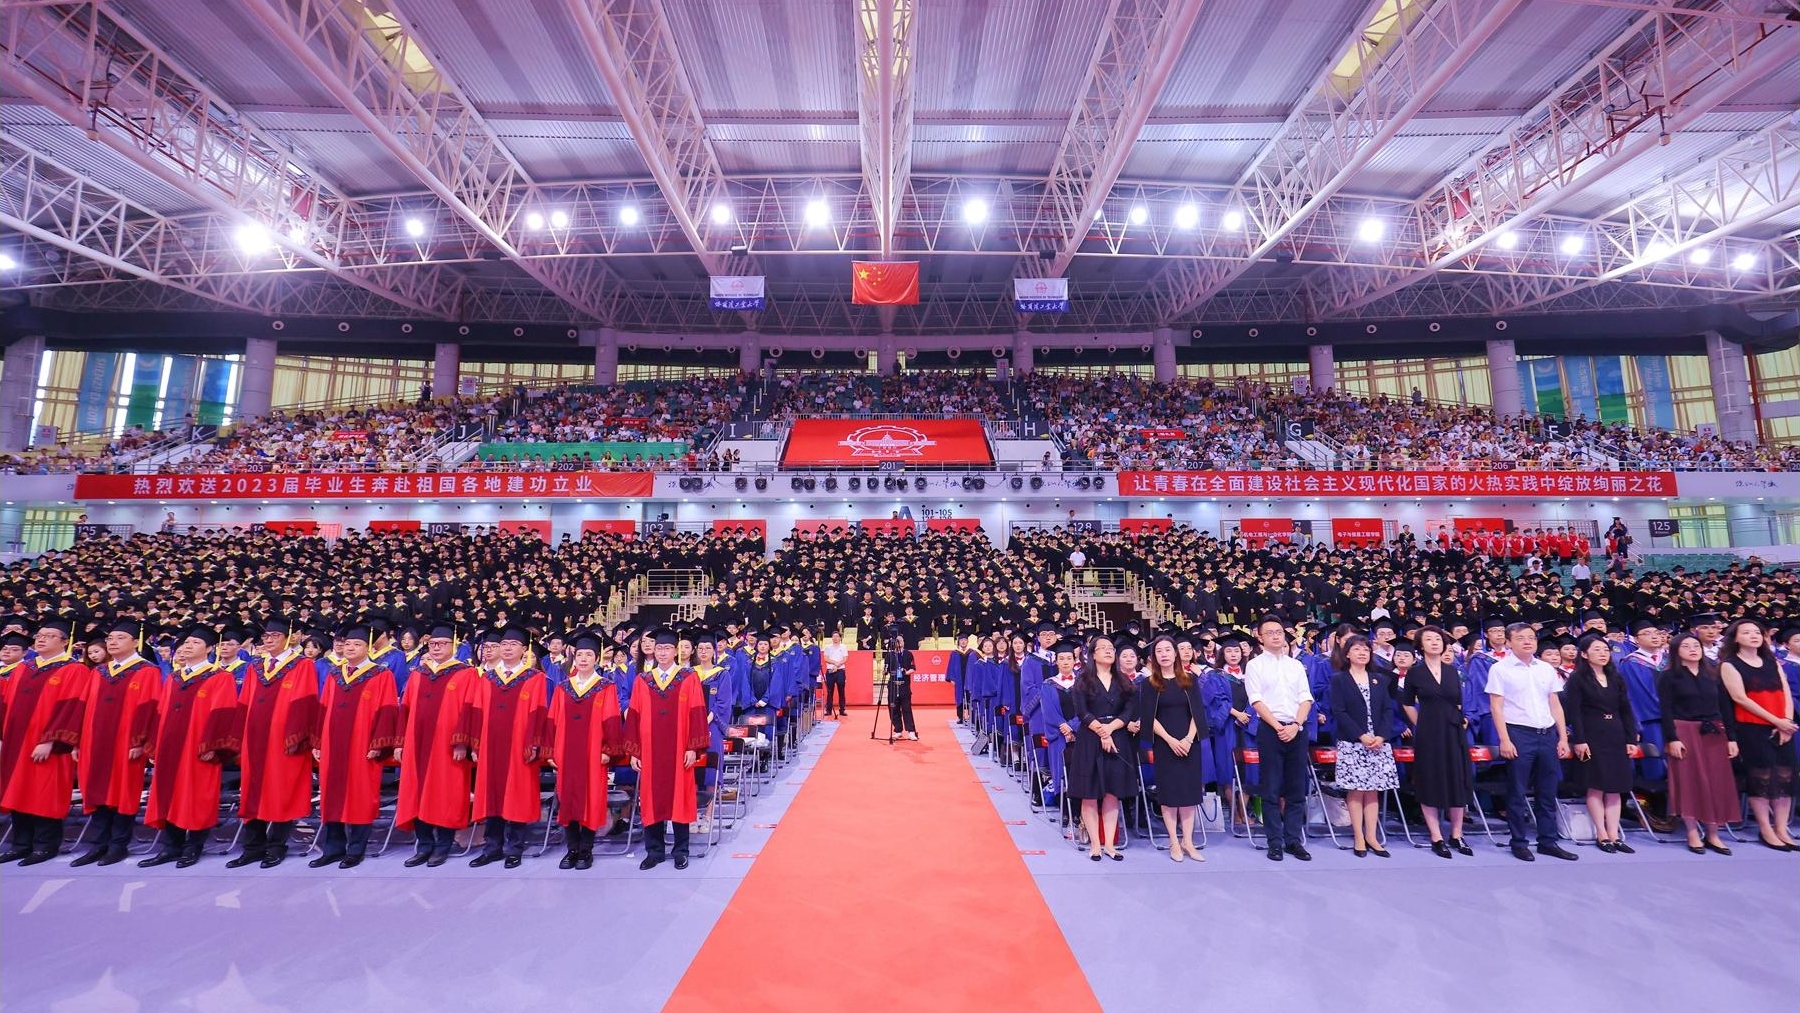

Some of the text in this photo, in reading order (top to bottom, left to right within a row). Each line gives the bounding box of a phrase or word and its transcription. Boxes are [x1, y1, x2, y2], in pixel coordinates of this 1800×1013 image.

[192, 427, 203, 440] K
[457, 425, 466, 440] J
[730, 423, 737, 438] I
[1024, 422, 1036, 436] H
[1289, 423, 1302, 437] G
[1548, 425, 1559, 440] F
[248, 464, 263, 472] 203
[558, 462, 574, 471] 202
[881, 462, 897, 470] 201
[1187, 461, 1203, 470] 207
[1492, 461, 1509, 470] 206
[133, 475, 593, 495] 热烈欢送2023届毕业生奔赴祖国各地建功立业
[1133, 475, 1663, 492] 让青春在全面建设社会主义现代化国家的火热实践中绽放绚丽之花
[921, 508, 953, 516] 101-105
[645, 523, 664, 533] 102
[1073, 522, 1092, 533] 128
[1653, 521, 1670, 531] 125
